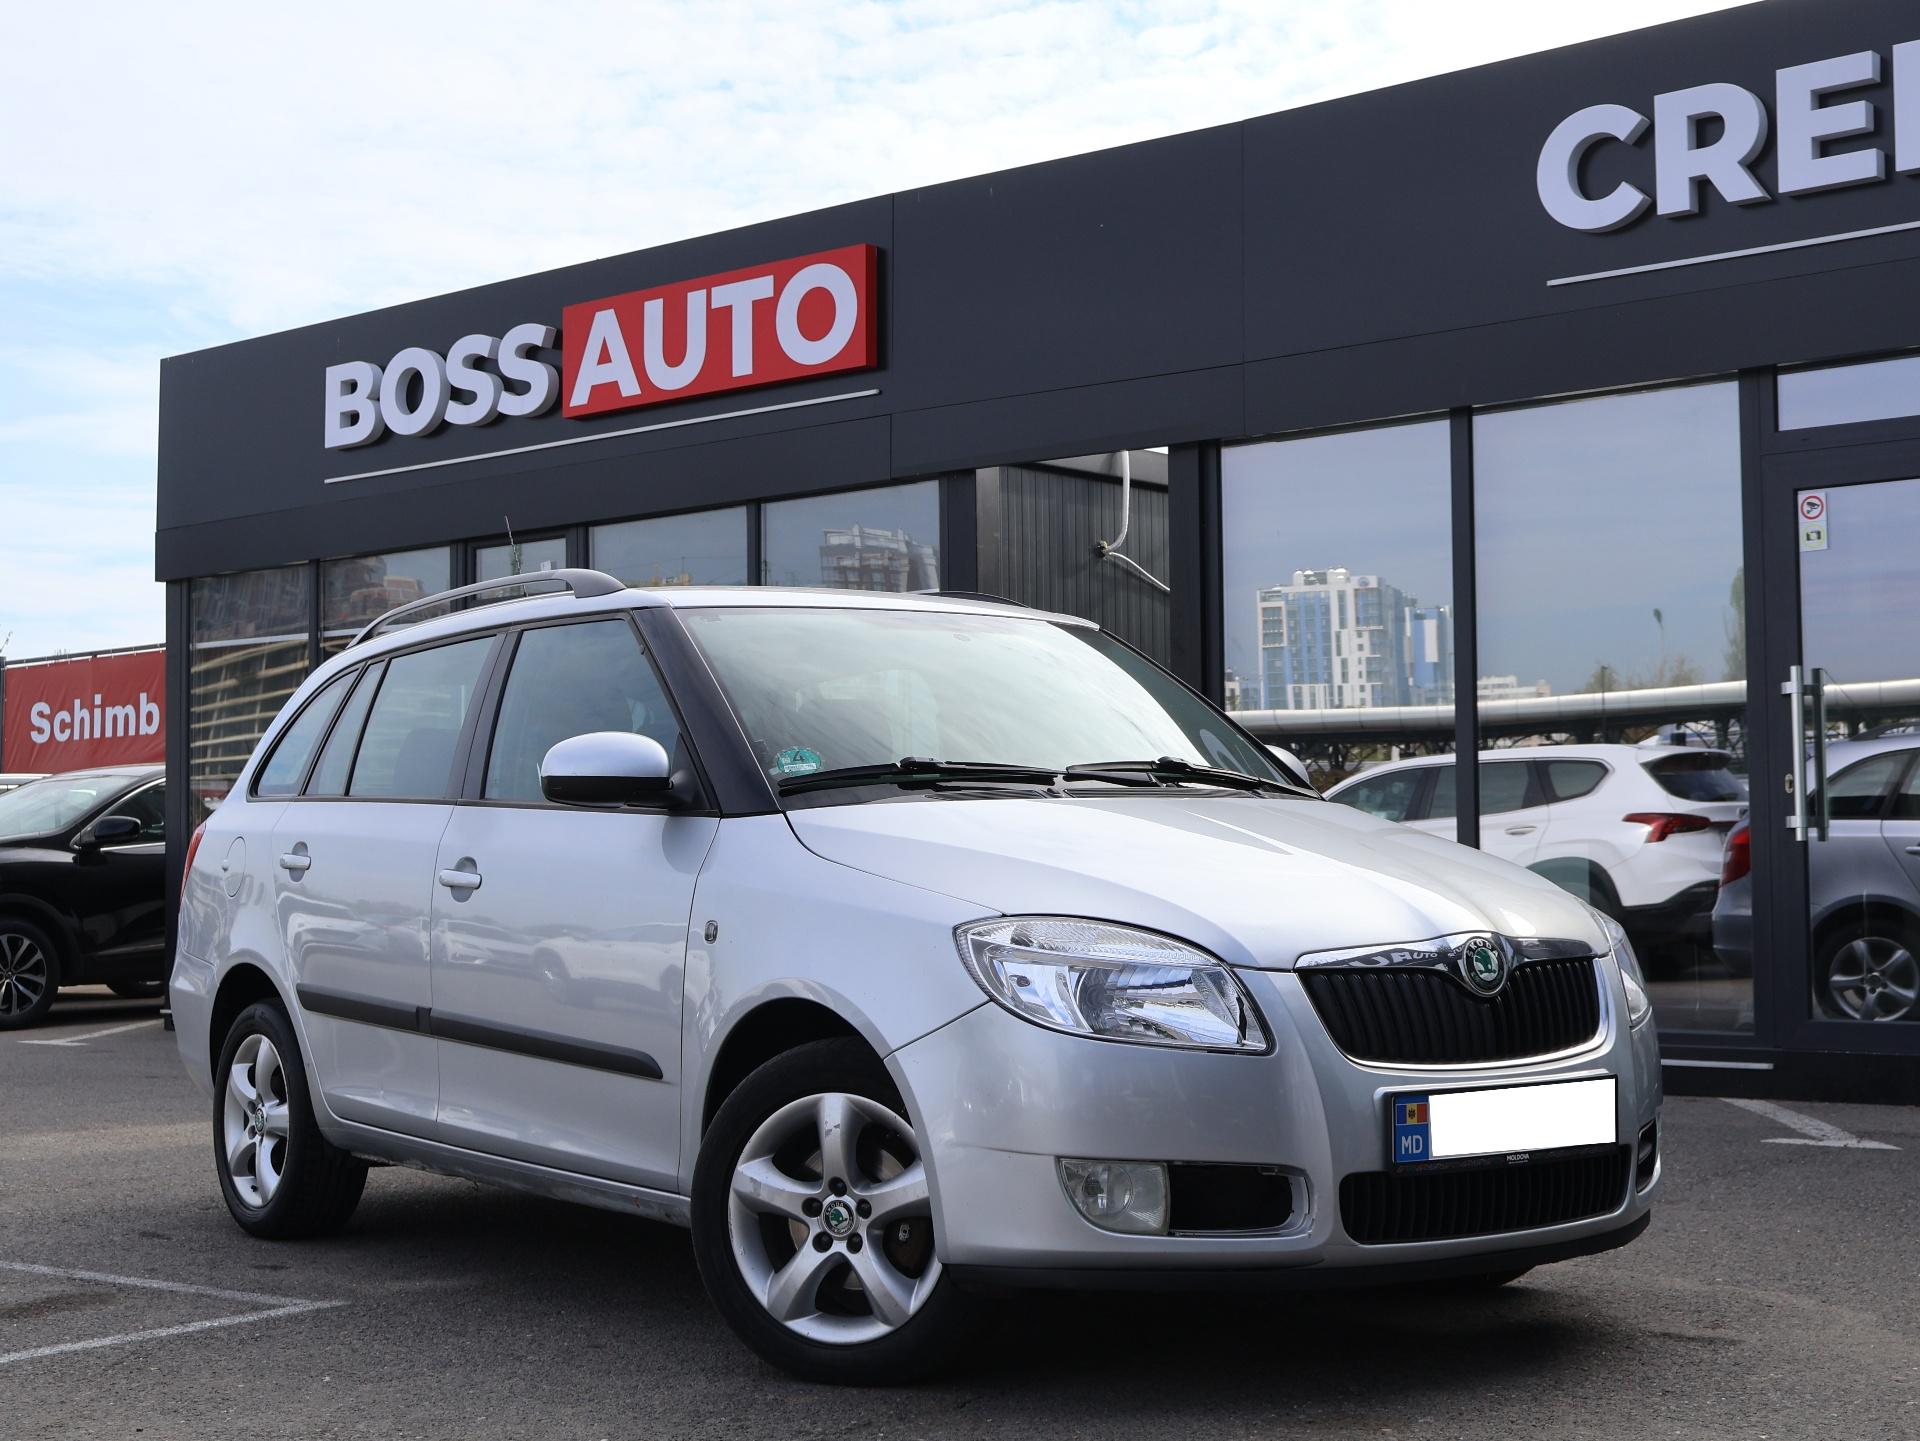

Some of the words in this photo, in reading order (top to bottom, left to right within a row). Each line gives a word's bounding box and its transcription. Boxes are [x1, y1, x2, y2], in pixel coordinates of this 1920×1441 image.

[1537, 40, 1920, 233] CRE
[325, 322, 558, 450] BOSS
[569, 263, 858, 407] AUTO
[30, 692, 160, 744] Schimb
[1401, 1135, 1423, 1155] MD
[1506, 1153, 1530, 1161] MOLDOVA
